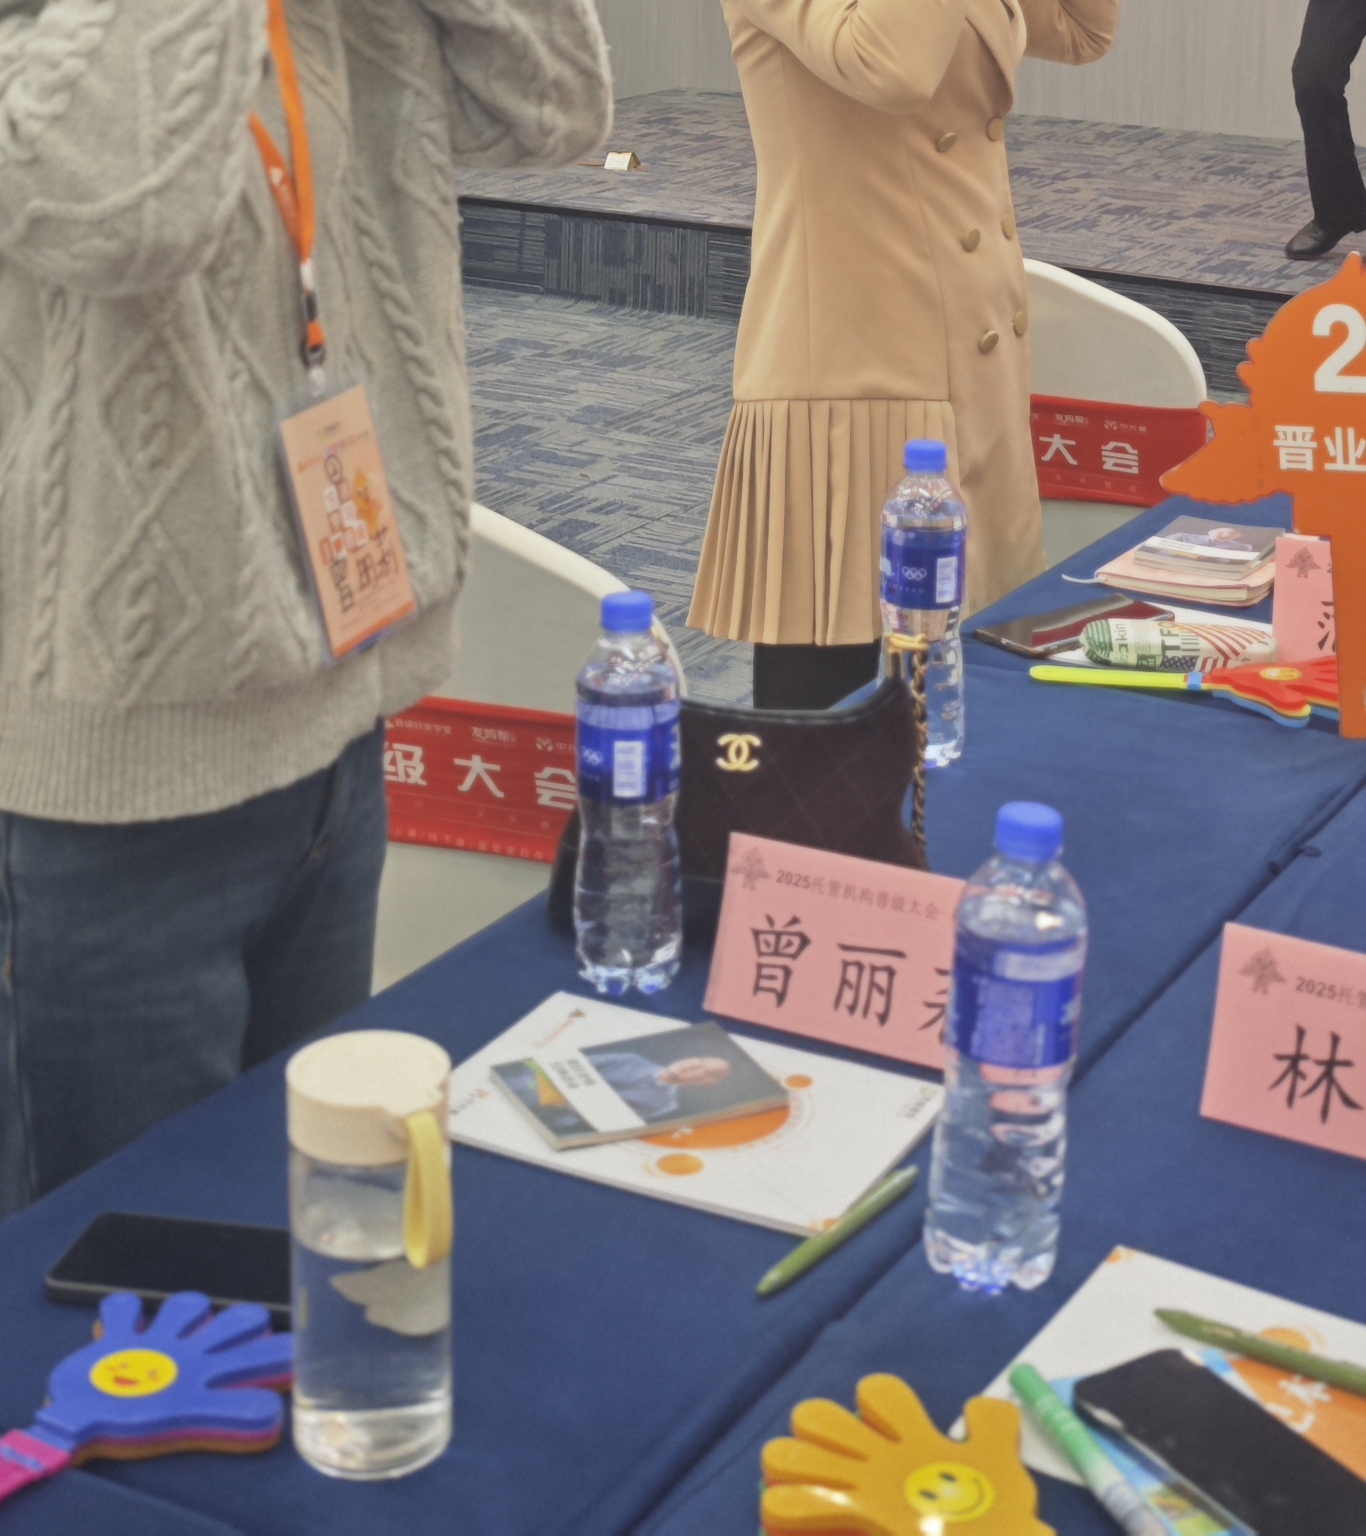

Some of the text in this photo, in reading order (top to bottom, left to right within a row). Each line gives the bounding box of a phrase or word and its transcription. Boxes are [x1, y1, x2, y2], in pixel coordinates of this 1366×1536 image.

[1039, 433, 1139, 474] 大会
[383, 741, 578, 811] 级大会
